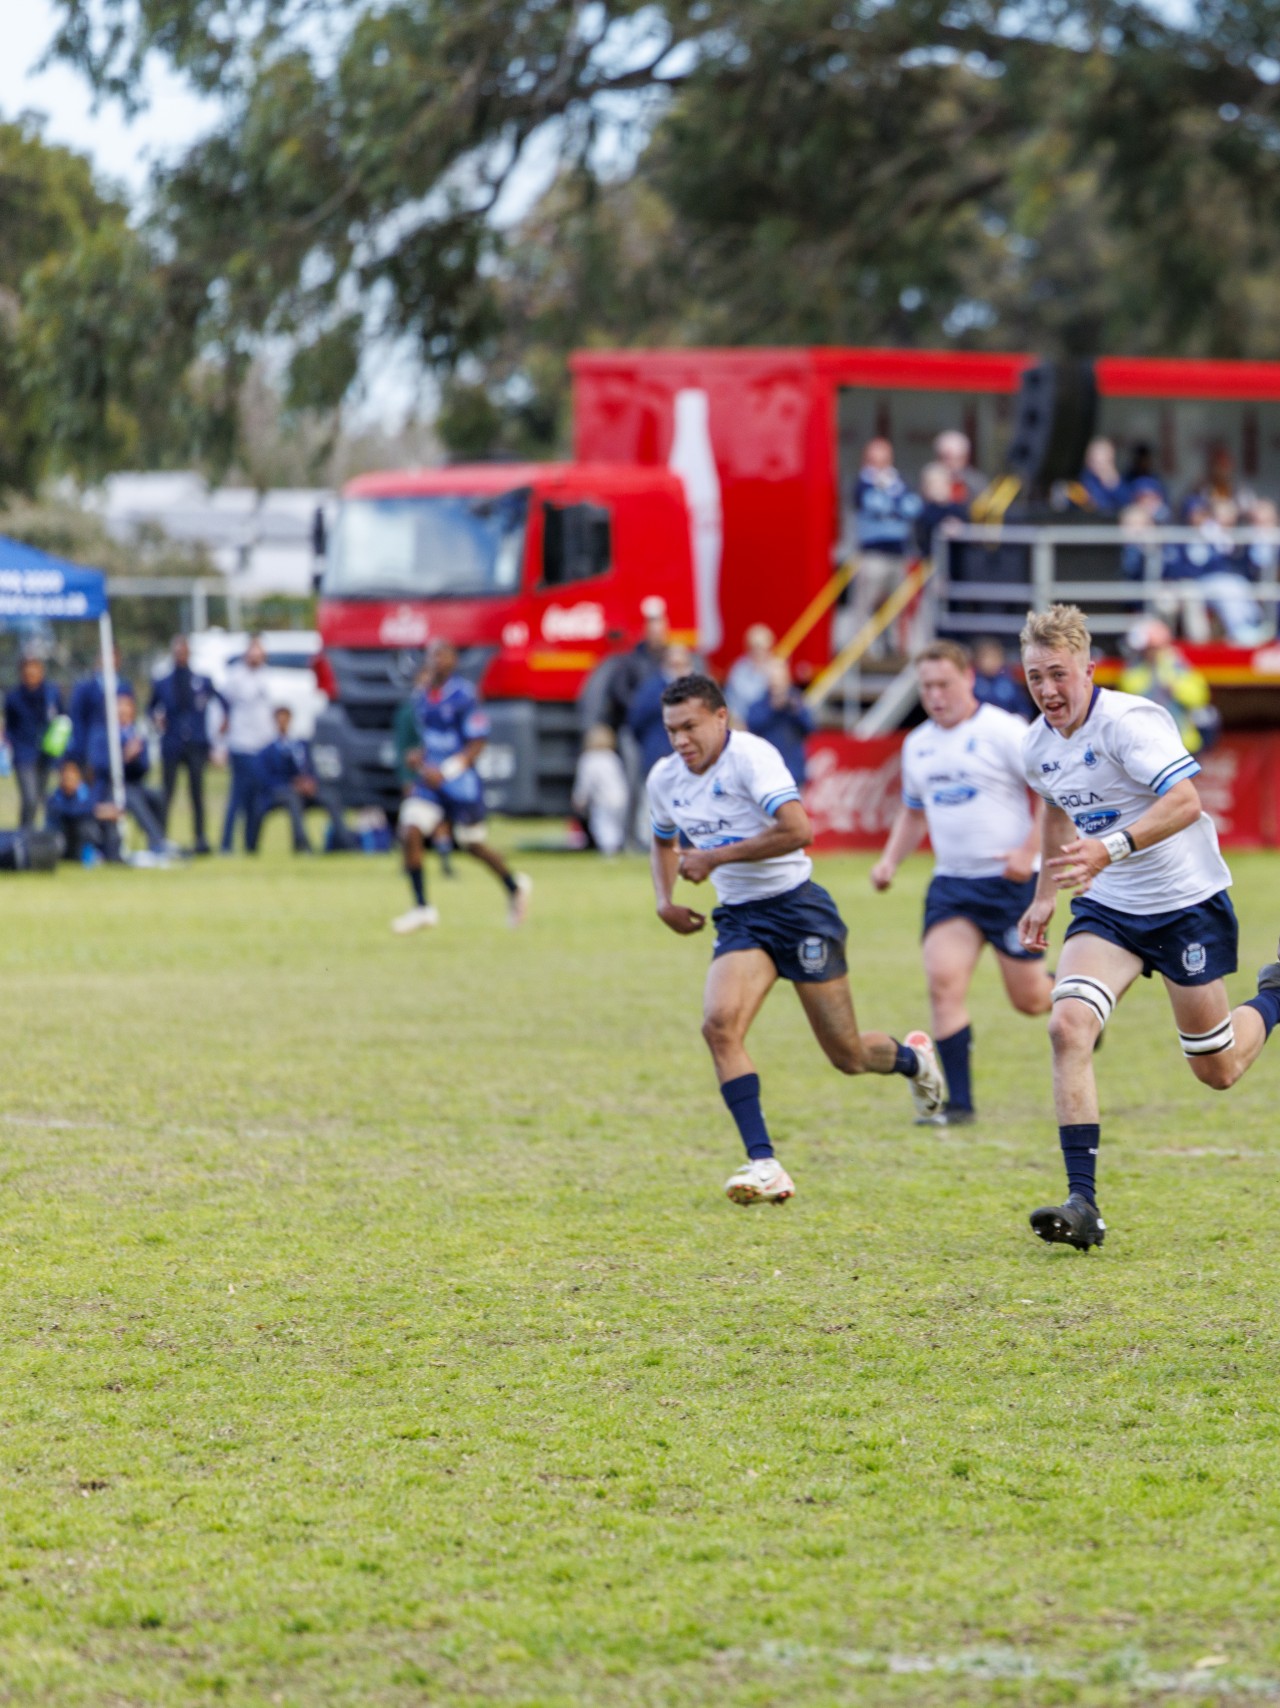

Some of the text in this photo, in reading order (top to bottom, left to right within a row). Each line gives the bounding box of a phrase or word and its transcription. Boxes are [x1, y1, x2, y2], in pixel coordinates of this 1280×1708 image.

[1042, 761, 1061, 773] BLK
[1059, 792, 1104, 808] ROLA
[687, 819, 732, 837] ROLA
